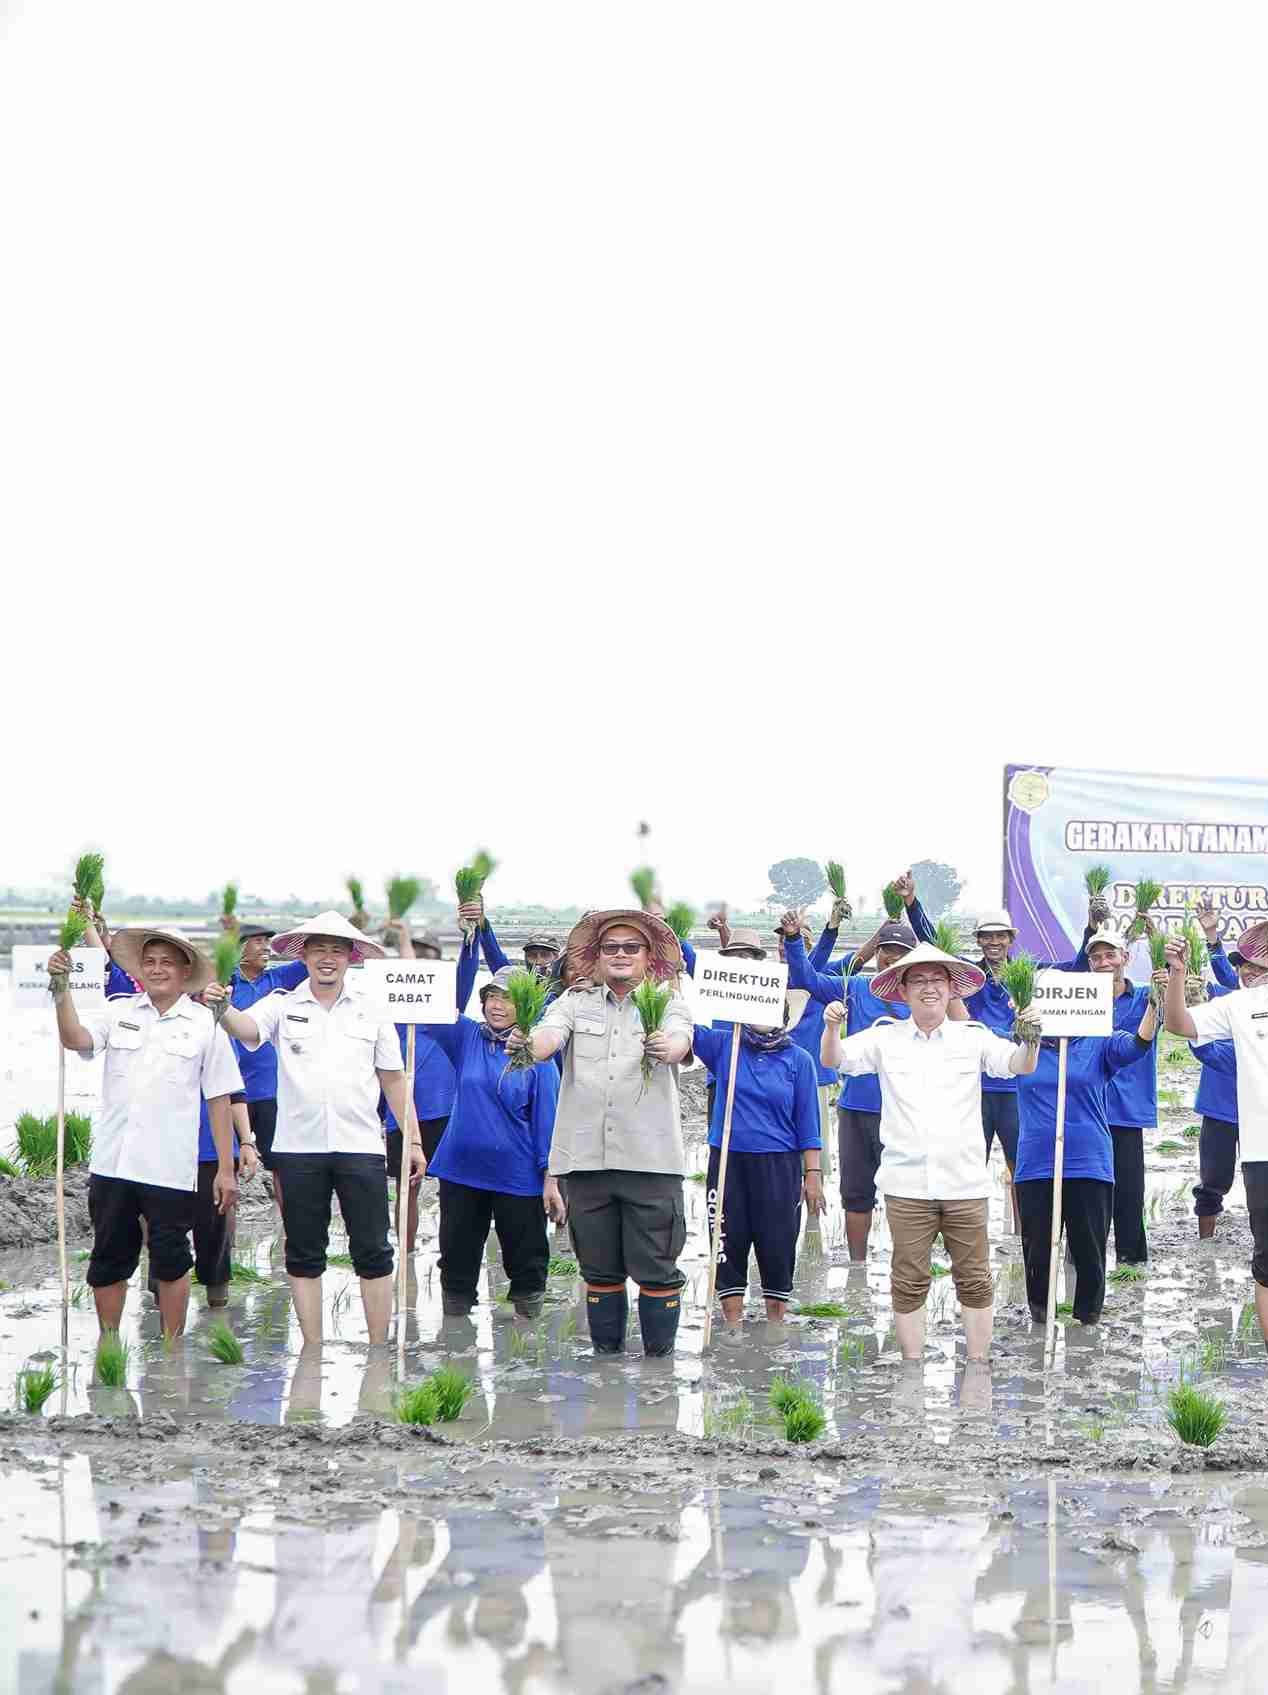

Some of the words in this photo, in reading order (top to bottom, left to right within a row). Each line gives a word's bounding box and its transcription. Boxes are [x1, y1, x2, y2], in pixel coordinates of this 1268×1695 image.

[1066, 821, 1183, 852] GERAKAN
[386, 973, 436, 984] CAMAT
[703, 969, 780, 988] DIREKTUR
[388, 993, 432, 1003] BABAT
[699, 988, 780, 1005] PERLINDUNGAN
[1034, 987, 1097, 999] DIRJEN
